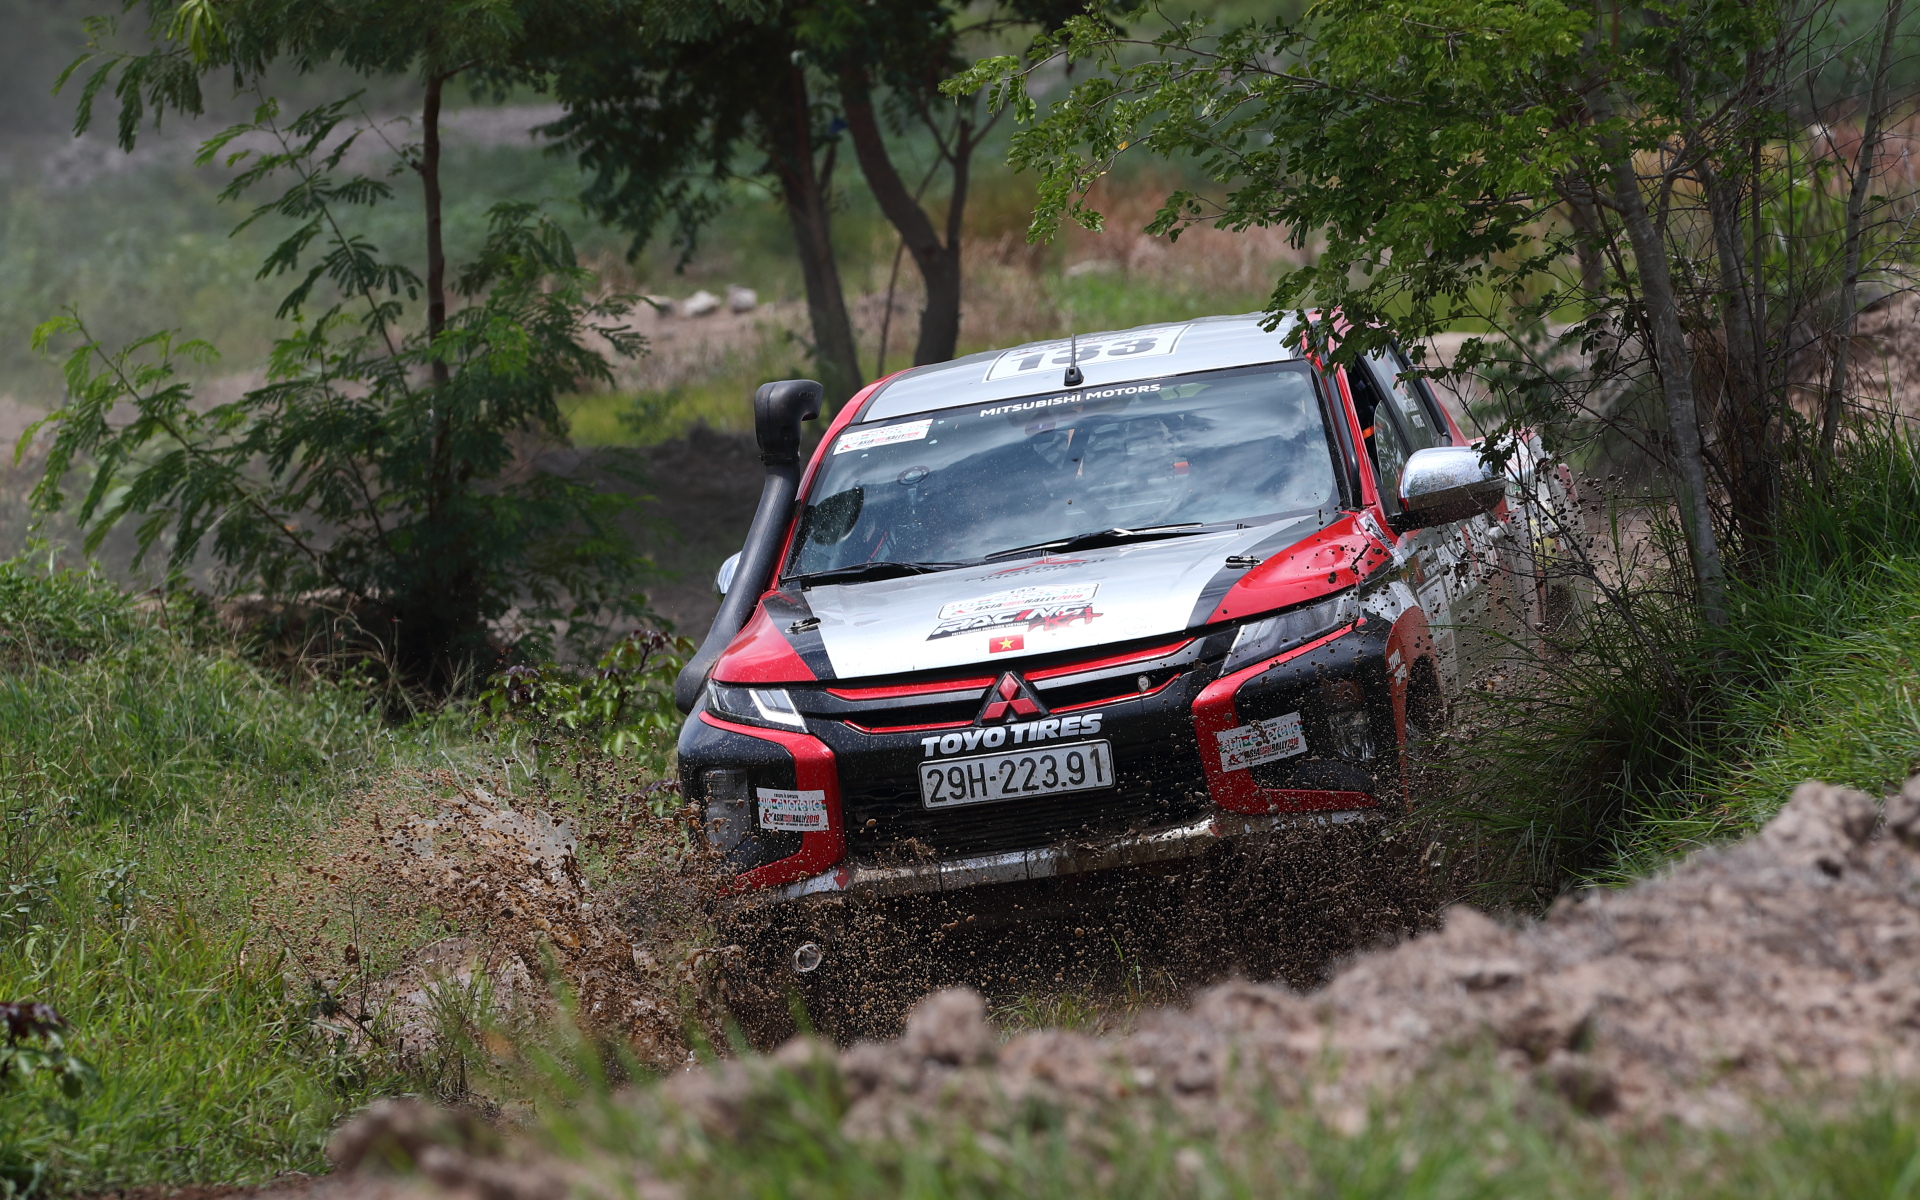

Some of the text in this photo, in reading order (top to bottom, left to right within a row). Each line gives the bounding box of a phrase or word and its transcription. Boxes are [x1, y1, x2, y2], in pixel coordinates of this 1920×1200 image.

[1010, 337, 1159, 372] 133
[979, 383, 1161, 418] MITSUBISHI MOTORS
[929, 602, 1093, 636] RACING
[1004, 621, 1029, 629] VIETNAM
[921, 713, 1103, 758] TOYO TIRES
[926, 747, 1104, 803] 29H-223.91
[792, 814, 806, 823] RALLY
[805, 814, 820, 823] 2019
